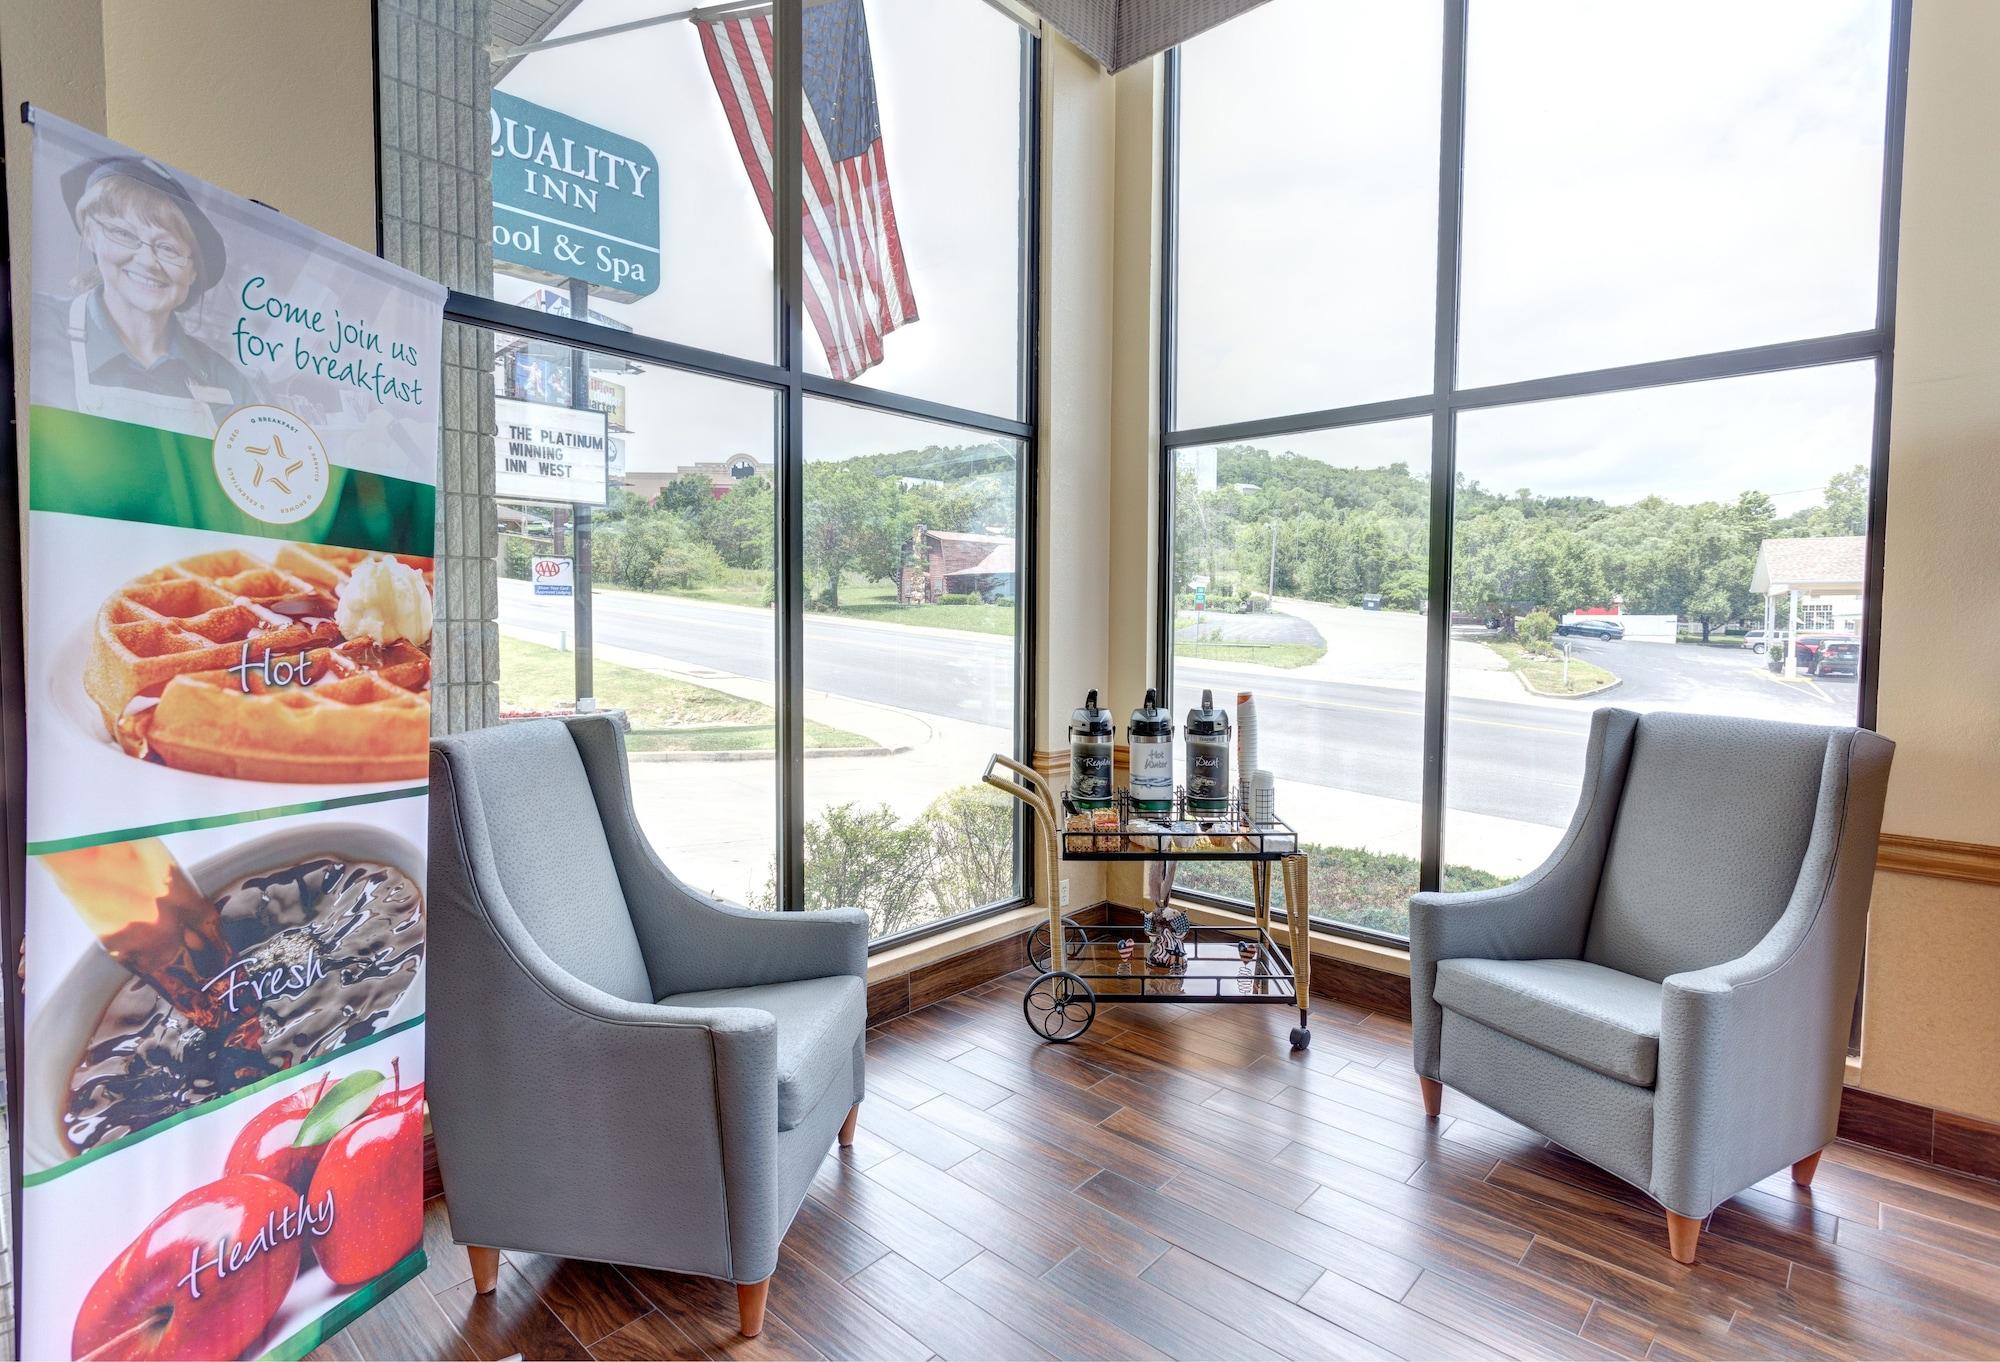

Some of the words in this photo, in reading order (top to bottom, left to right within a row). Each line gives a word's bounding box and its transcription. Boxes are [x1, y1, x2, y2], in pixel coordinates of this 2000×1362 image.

[524, 168, 599, 213] INN
[493, 225, 542, 255] ool
[553, 234, 586, 266] &
[596, 245, 646, 283] Spa
[242, 277, 325, 332] Come
[329, 310, 383, 353] join
[392, 342, 417, 366] us
[232, 317, 284, 365] for
[295, 337, 422, 405] breakfast
[509, 425, 532, 441] THE
[541, 429, 603, 450] PLATINUM
[509, 442, 564, 461] WINNING
[505, 458, 527, 473] INN
[539, 461, 572, 478] WEST
[536, 561, 560, 577] AAA
[228, 642, 312, 693] Hot
[1144, 759, 1168, 770] Water
[1148, 749, 1165, 760] Hot
[1195, 755, 1219, 768] Decaf
[201, 949, 328, 1012] Fresh
[177, 1188, 335, 1298] Healthy
